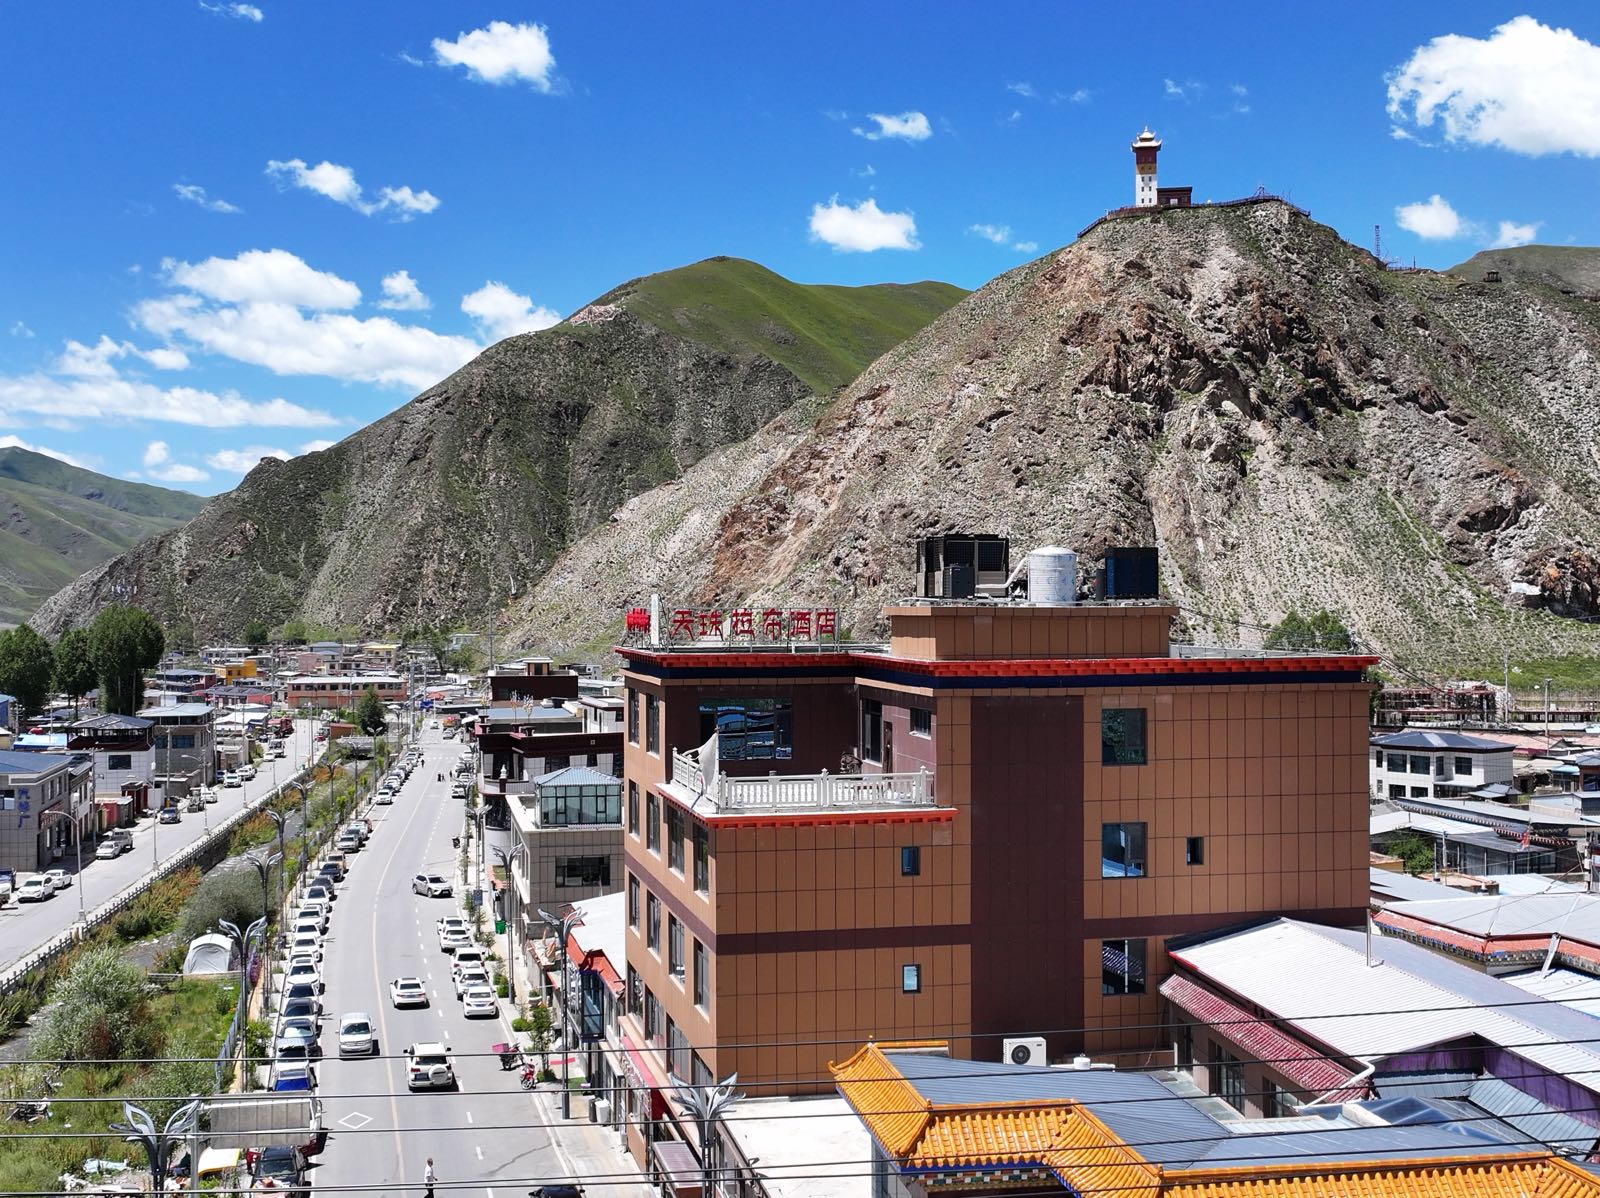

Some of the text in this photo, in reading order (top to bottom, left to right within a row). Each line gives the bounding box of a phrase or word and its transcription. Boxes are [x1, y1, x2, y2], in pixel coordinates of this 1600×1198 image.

[670, 607, 836, 641] 天珠拉布酒店
